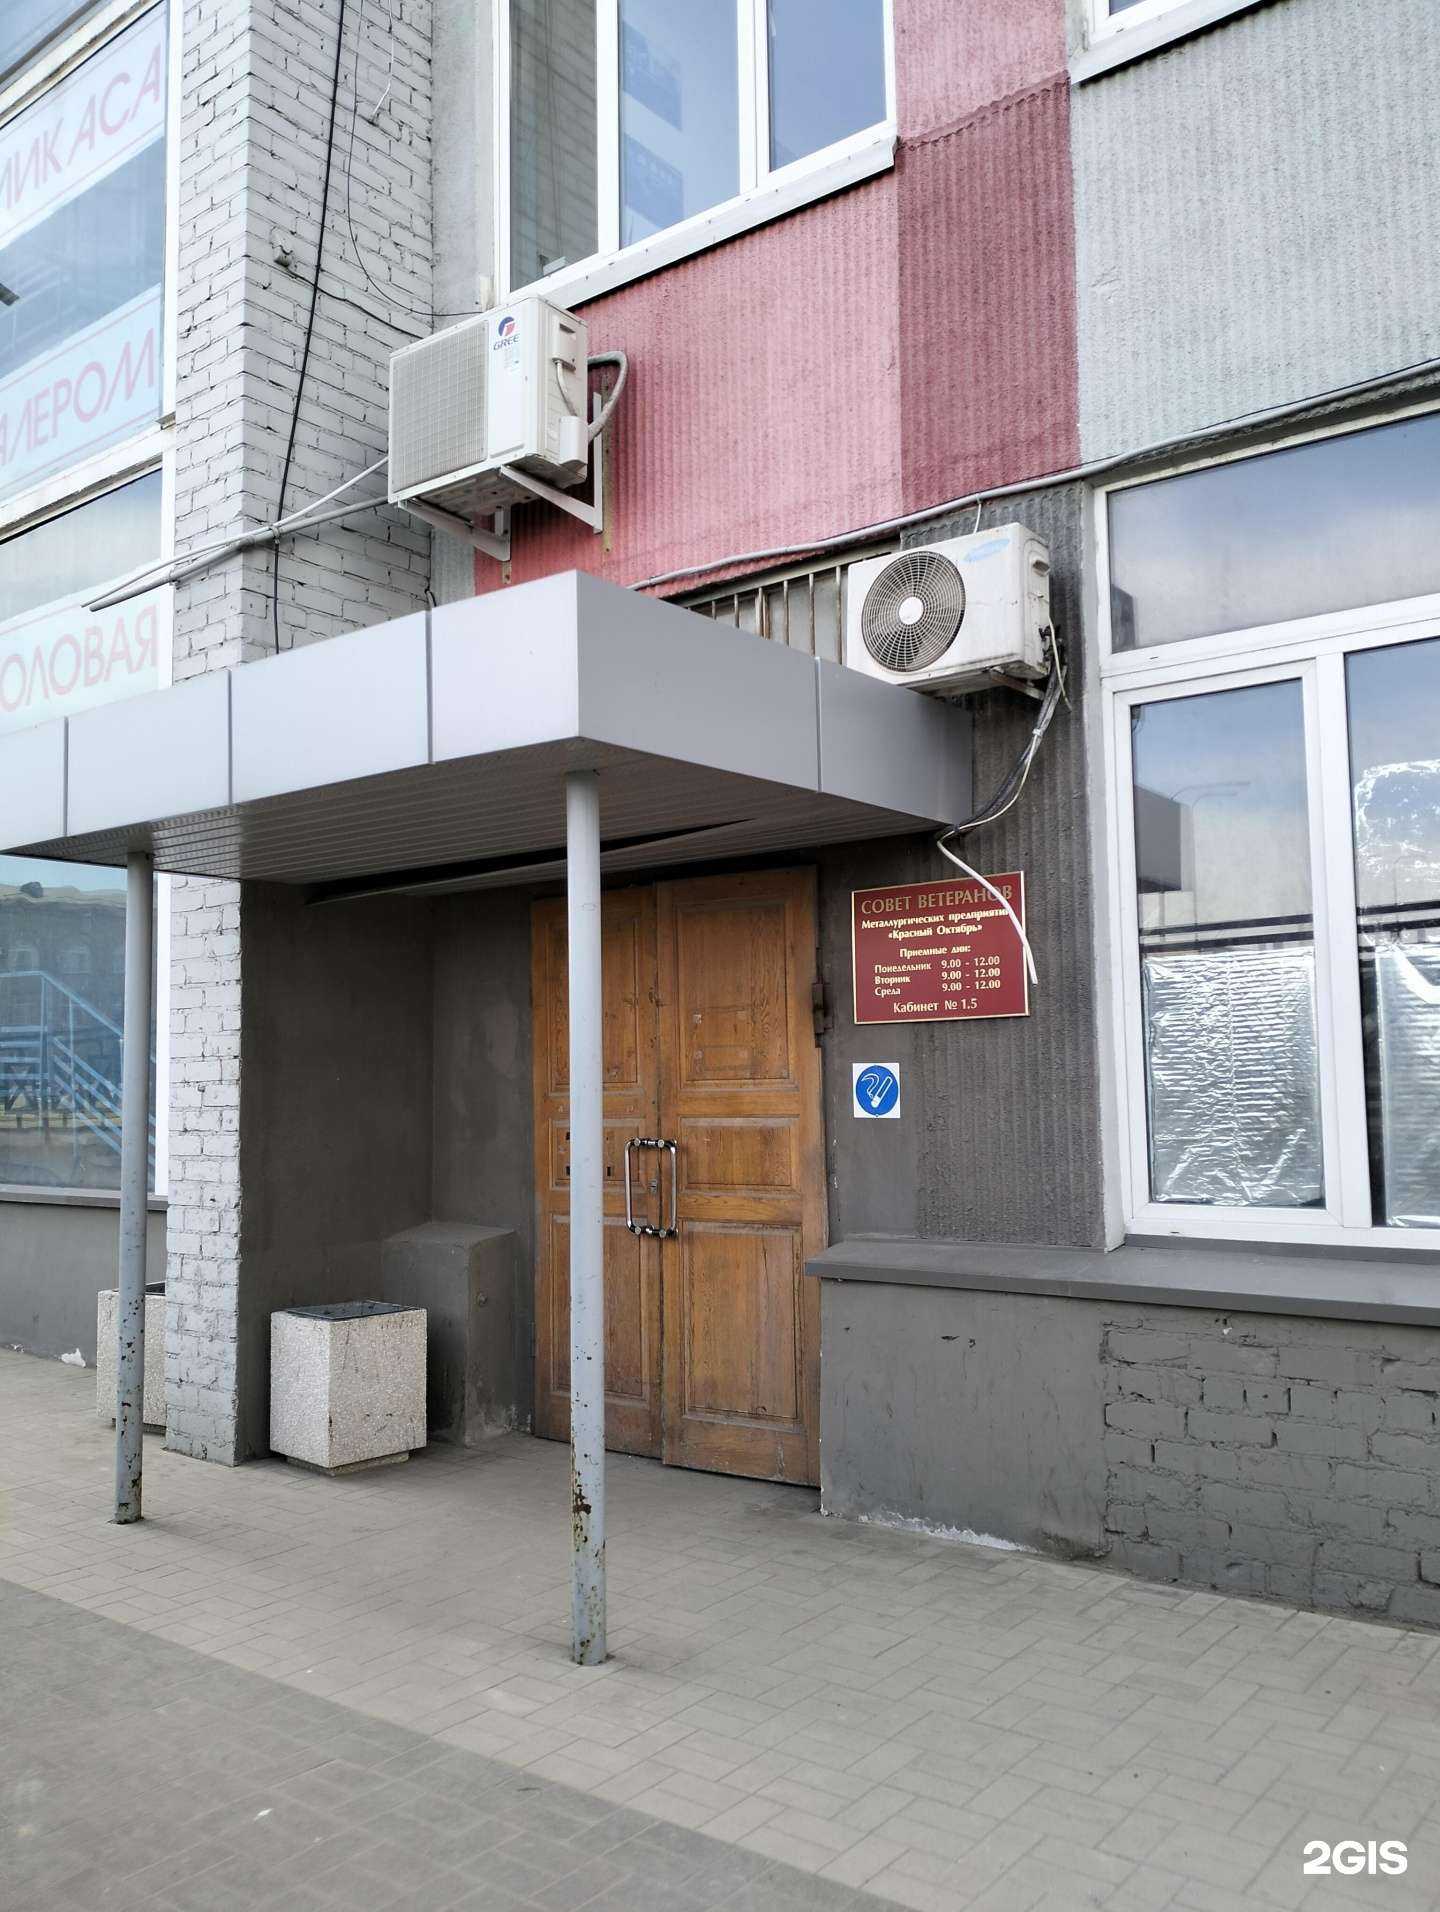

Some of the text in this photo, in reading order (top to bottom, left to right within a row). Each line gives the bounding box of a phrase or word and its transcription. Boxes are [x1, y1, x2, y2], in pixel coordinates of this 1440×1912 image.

[493, 333, 521, 350] GREE
[0, 604, 158, 712] ОЛОВАЯ
[861, 885, 1013, 914] СОВЕТ ВЕТЕРАНОВ
[861, 914, 944, 929] Металлургических
[888, 923, 983, 941] «Красный Октябрь»
[900, 945, 971, 959] Приемные дни:
[874, 963, 931, 973] Понедельник
[941, 959, 961, 969] 9.00
[974, 956, 1000, 966] 12.00
[874, 975, 911, 986] Вторник
[941, 970, 962, 980] 9.00
[974, 967, 1000, 978] 12.00
[874, 986, 901, 998] Среда
[942, 982, 962, 992] 9.00
[975, 979, 1001, 990] 12.00
[893, 998, 978, 1013] Кабинет № 1.5
